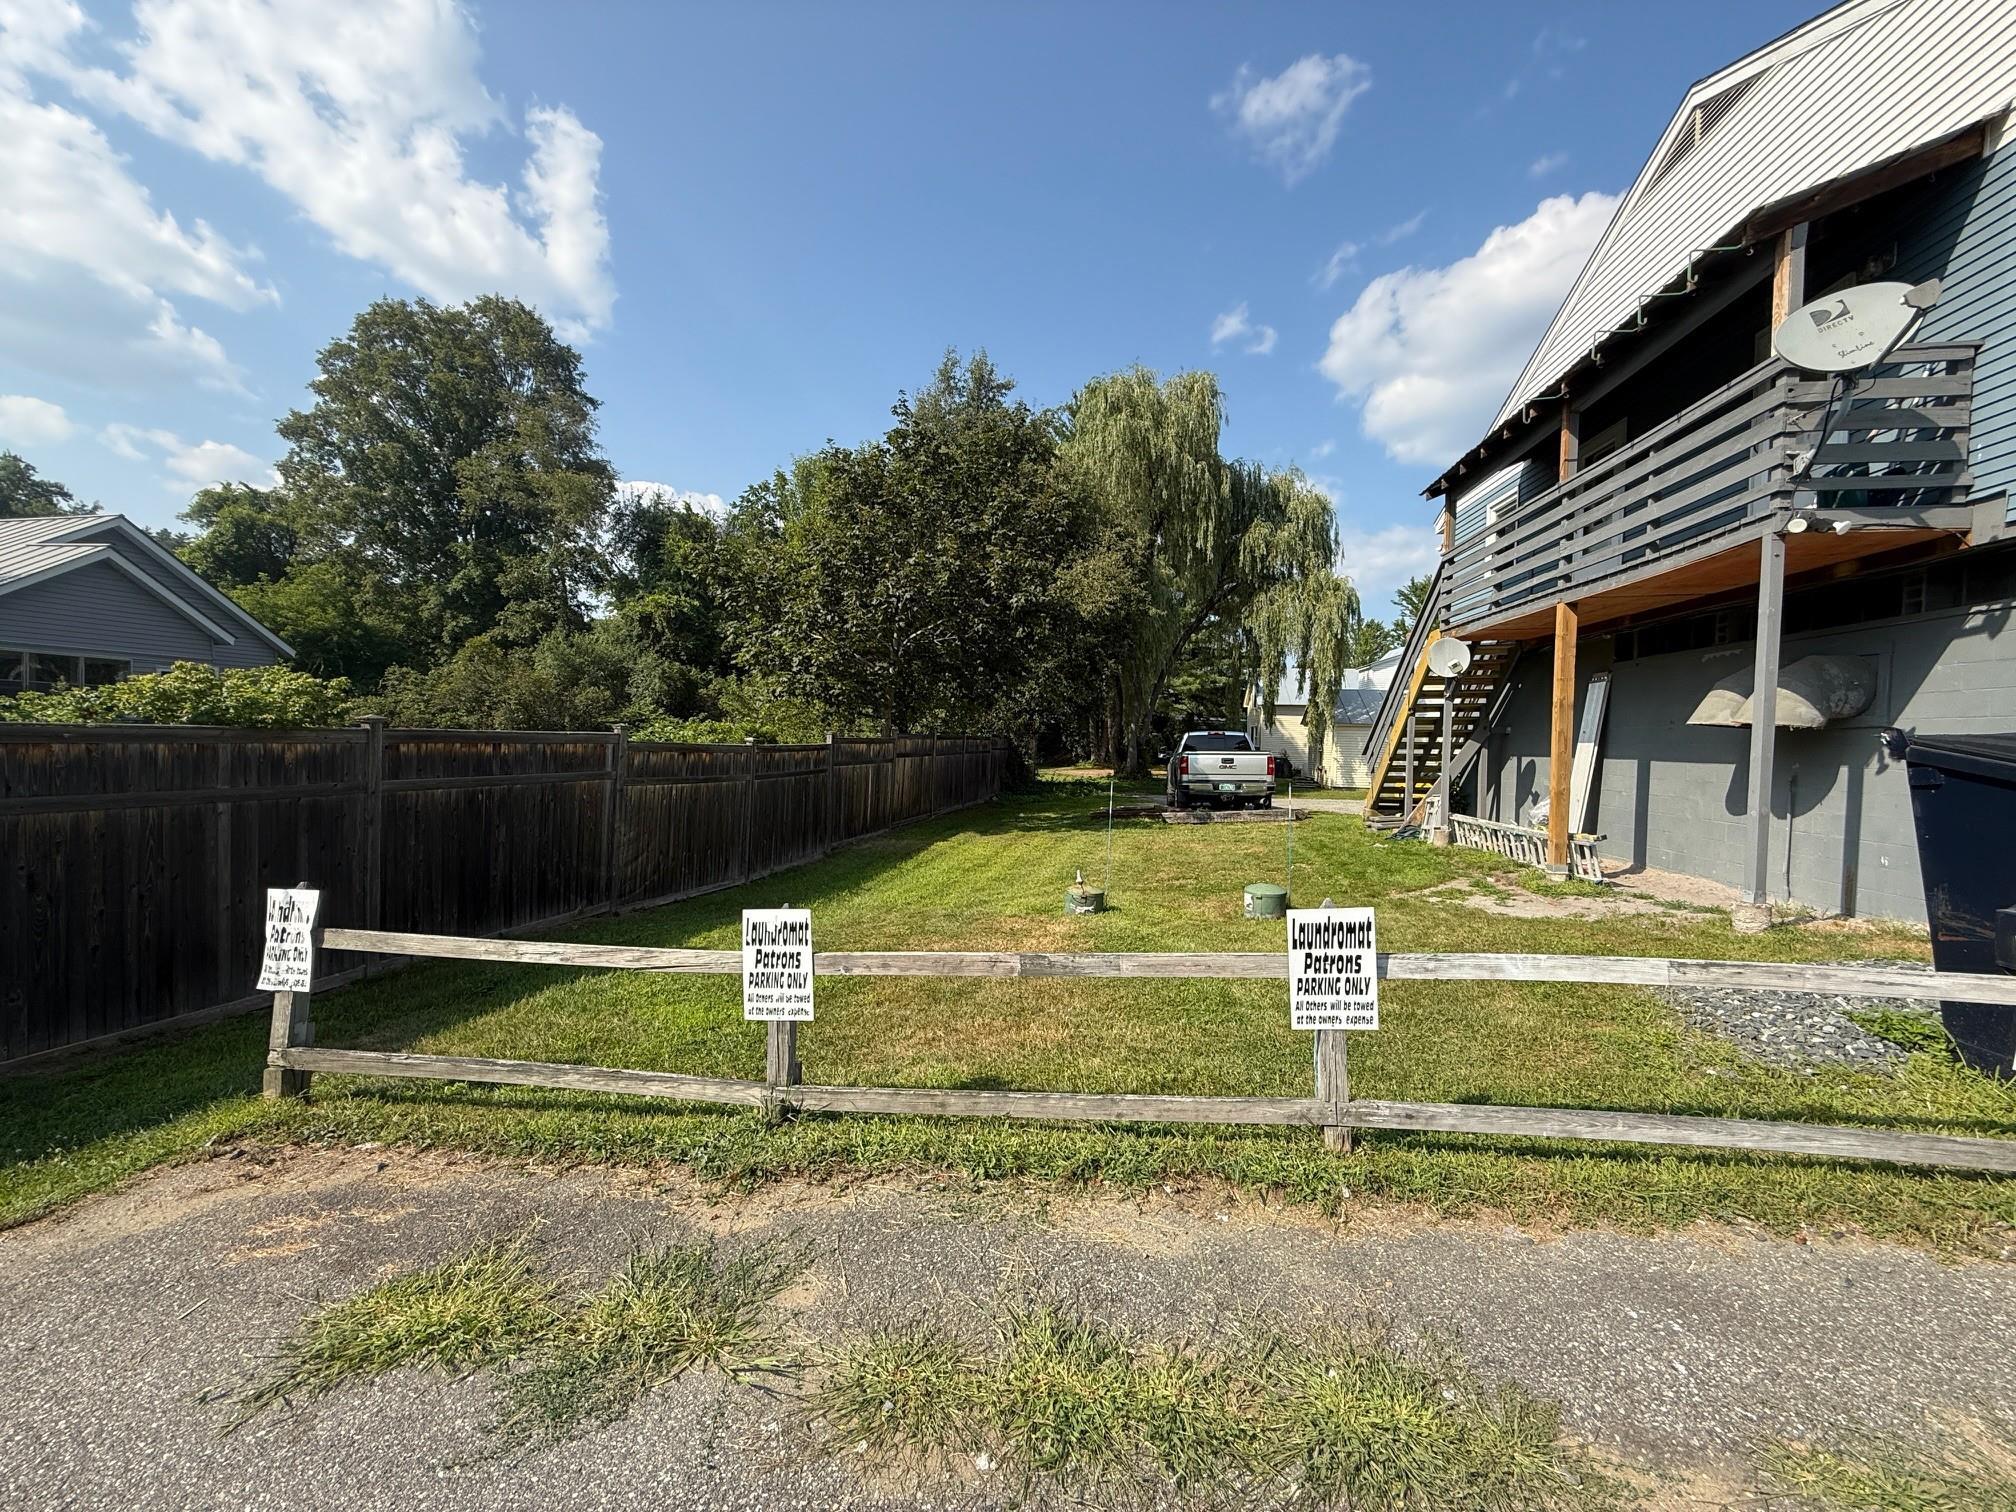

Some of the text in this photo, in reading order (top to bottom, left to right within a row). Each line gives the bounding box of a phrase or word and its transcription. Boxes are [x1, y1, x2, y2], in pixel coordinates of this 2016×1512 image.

[1817, 314, 1854, 333] DIRECTV
[746, 917, 809, 946] Laundromat
[1292, 916, 1372, 950] Laundromat
[755, 948, 801, 969] Patrons
[1304, 952, 1362, 974] Patrons
[749, 971, 808, 989] PARKING ONLY
[1297, 977, 1371, 995] PARKING ONLY
[1296, 1000, 1374, 1011] All Others will be towed
[1297, 1014, 1374, 1026] at the owners expense
